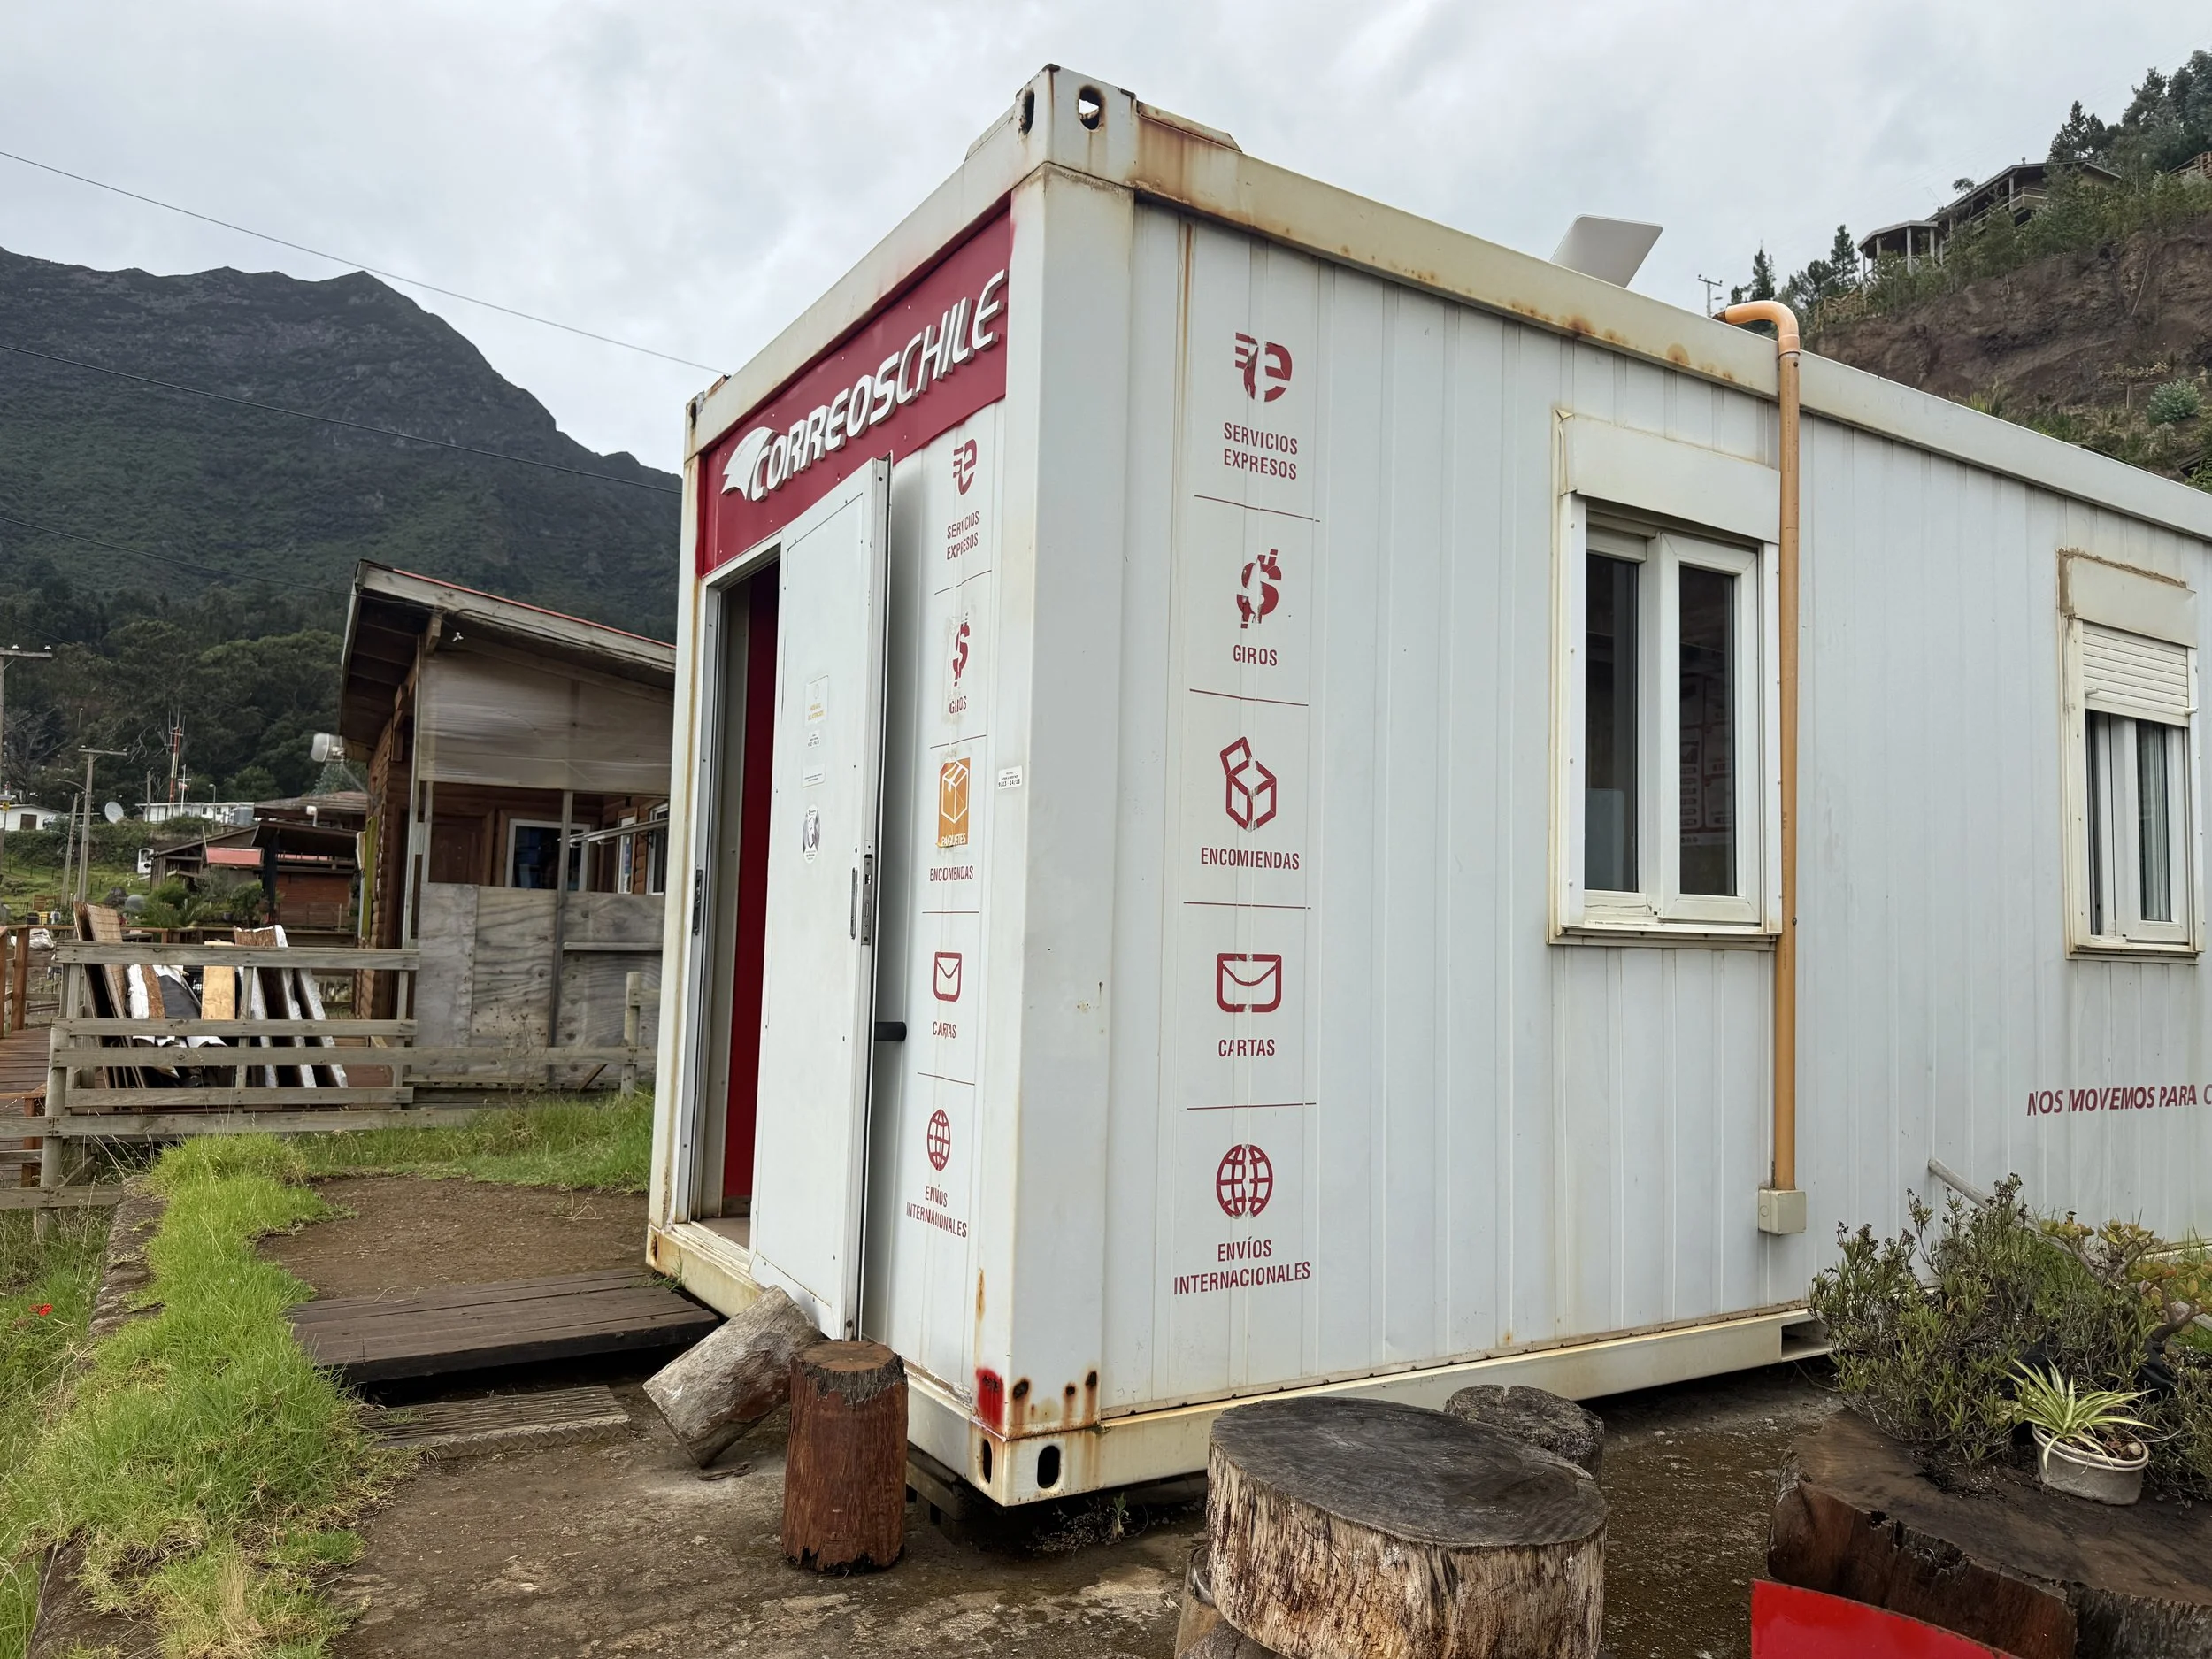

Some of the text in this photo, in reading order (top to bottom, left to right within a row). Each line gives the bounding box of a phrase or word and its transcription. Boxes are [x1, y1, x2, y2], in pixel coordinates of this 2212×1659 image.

[1224, 422, 1298, 455] SERVICIOS
[1224, 448, 1297, 480] EXPRESOS
[1233, 644, 1278, 666] GIROS
[930, 865, 974, 881] ENCOMENDAS
[1201, 847, 1300, 870] ENCOMIENDAS
[1218, 1039, 1276, 1056] CARTAS
[2027, 1089, 2063, 1116] NOS
[2068, 1087, 2155, 1112] MOVEMOS
[2159, 1084, 2197, 1107] PARA
[906, 1202, 968, 1239] INTERNAIONALES
[1217, 1236, 1272, 1262] ENVÍOS
[1174, 1261, 1311, 1295] INTERNACIONALES
